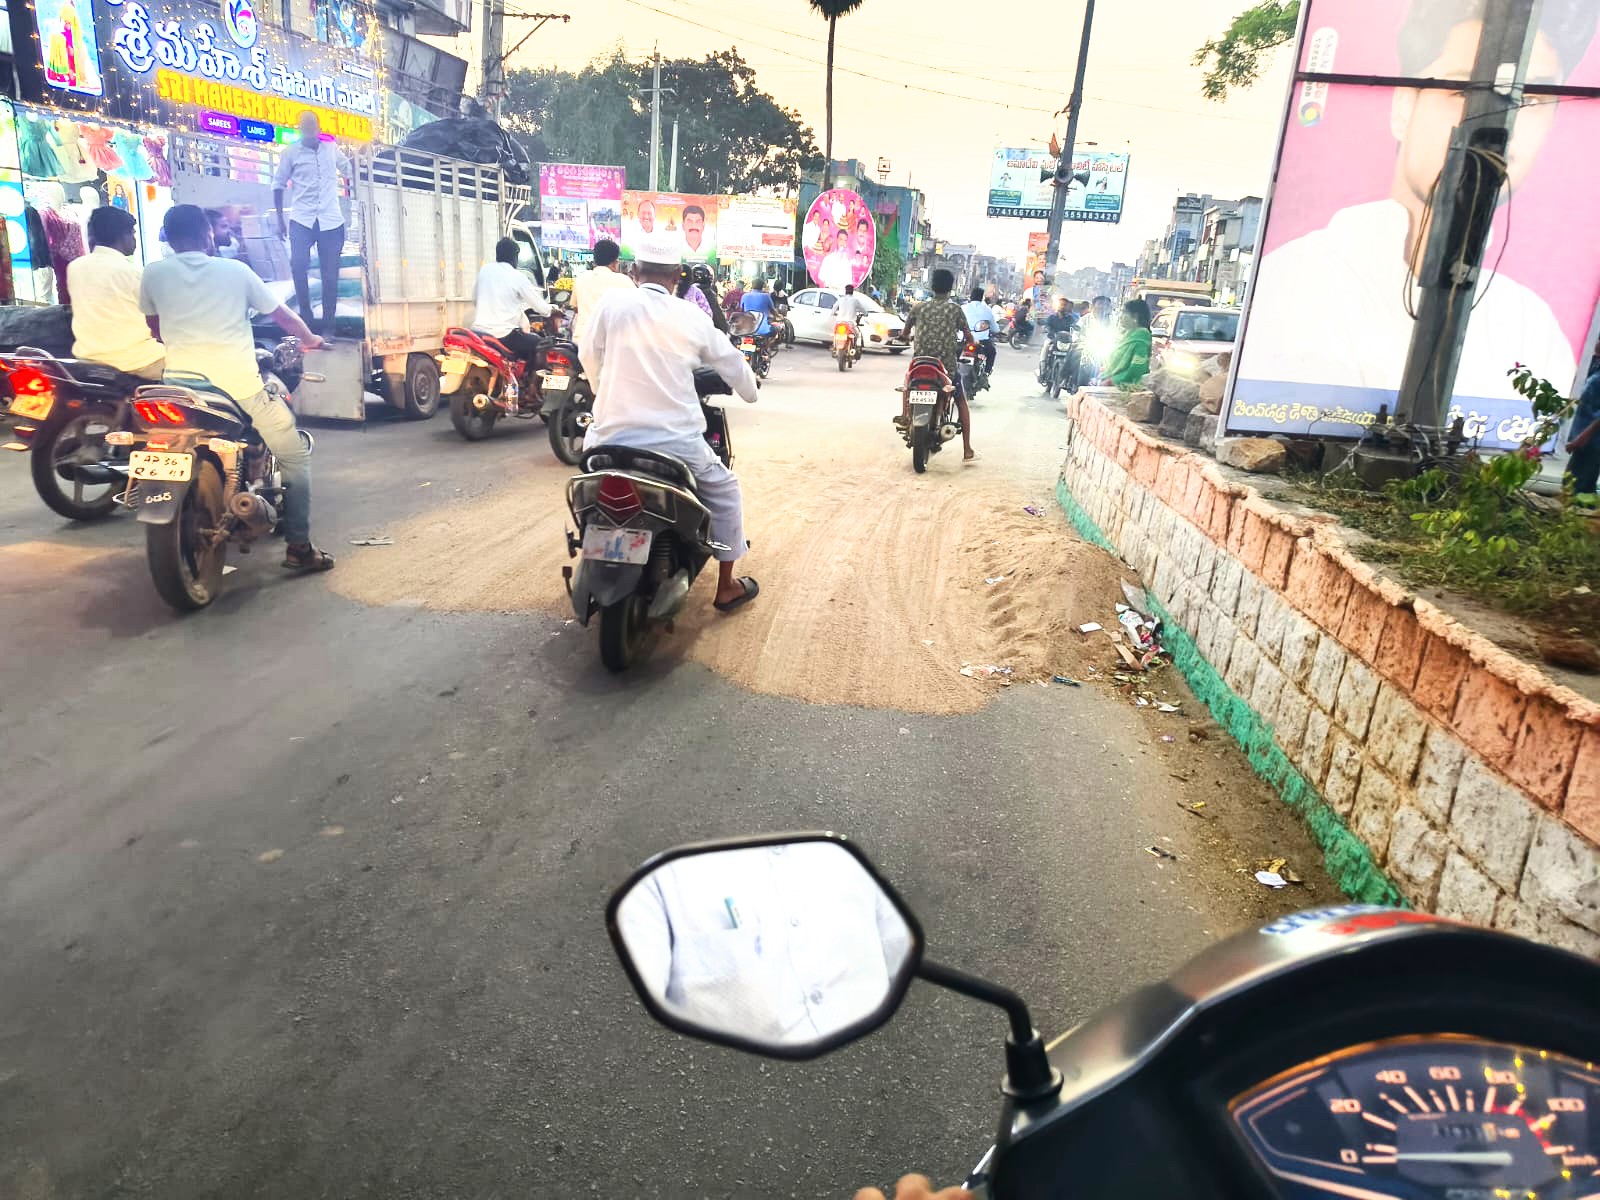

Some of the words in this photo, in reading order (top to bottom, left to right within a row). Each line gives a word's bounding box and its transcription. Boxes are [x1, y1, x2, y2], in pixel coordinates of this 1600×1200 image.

[114, 1, 156, 73] శ్రీ
[157, 68, 191, 103] SRI
[193, 76, 264, 118] MAHESH
[336, 112, 372, 142] MALL
[208, 117, 232, 129] SAREES
[246, 126, 267, 136] LADIES
[1376, 1069, 1407, 1084] 40
[1429, 1066, 1461, 1081] 60
[1486, 1069, 1517, 1084] 80
[1330, 1098, 1361, 1114] 20
[1547, 1098, 1586, 1112] 100
[1340, 1148, 1359, 1165] 0
